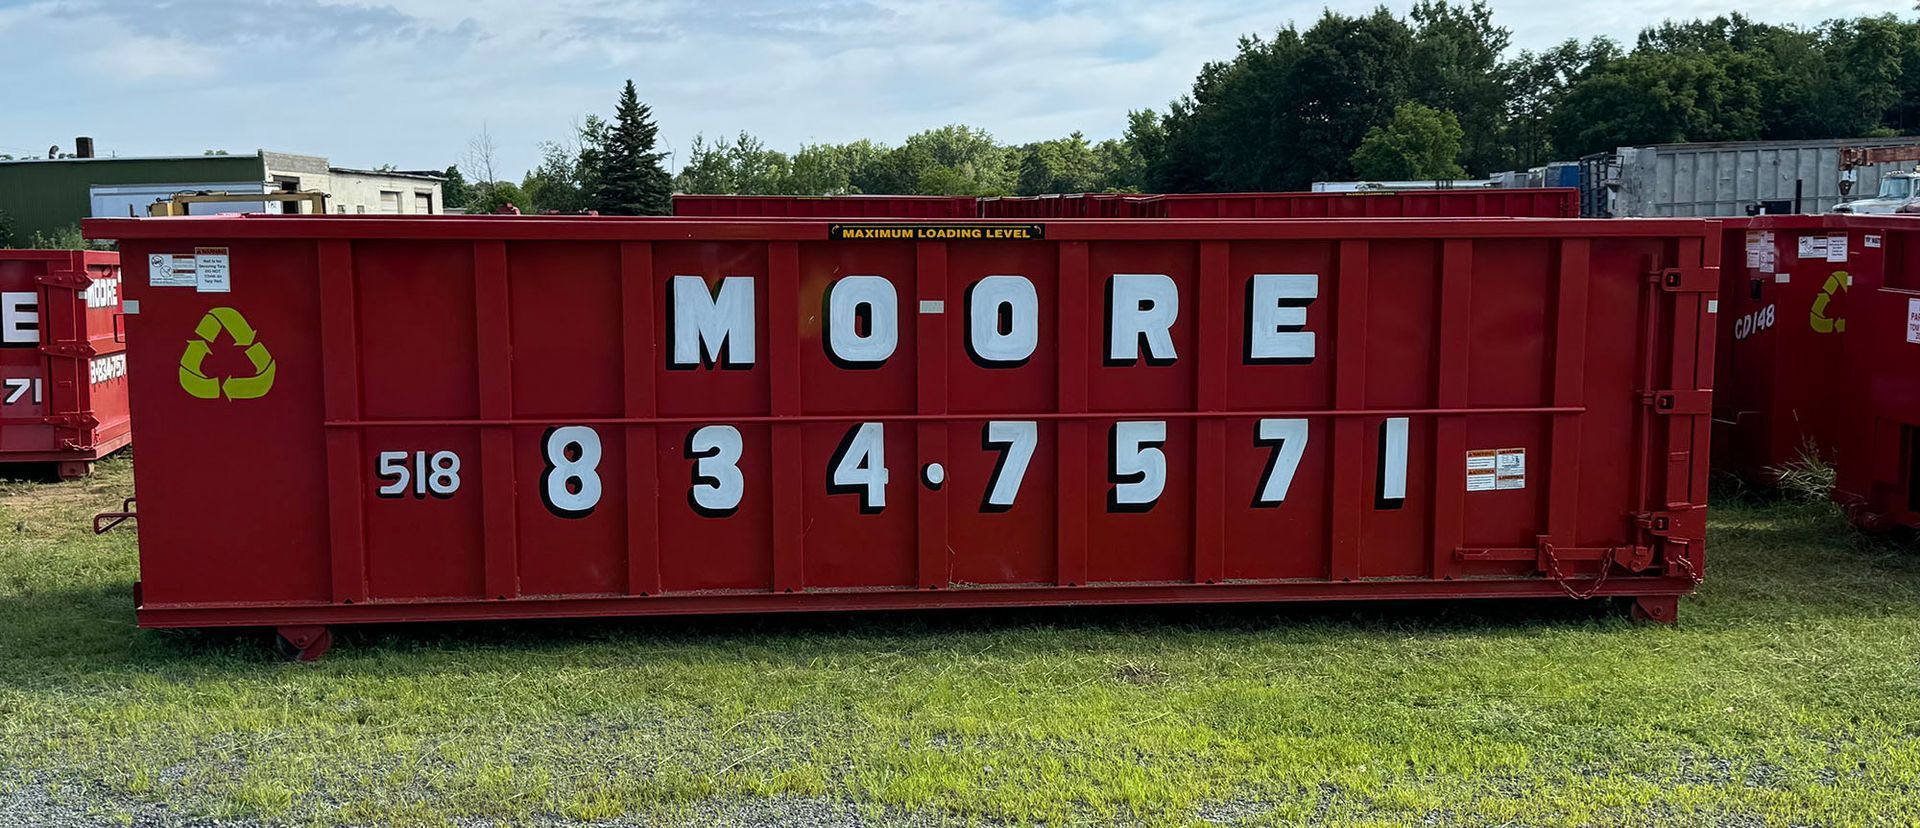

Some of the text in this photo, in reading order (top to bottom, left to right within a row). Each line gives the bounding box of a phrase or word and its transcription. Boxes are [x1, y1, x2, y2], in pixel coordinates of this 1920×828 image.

[842, 229, 1030, 239] MAXIMUM LOADING LEVEL
[668, 273, 1319, 368] MOORE
[1735, 303, 1775, 339] CD148
[4, 378, 42, 404] 71
[376, 450, 461, 497] 518
